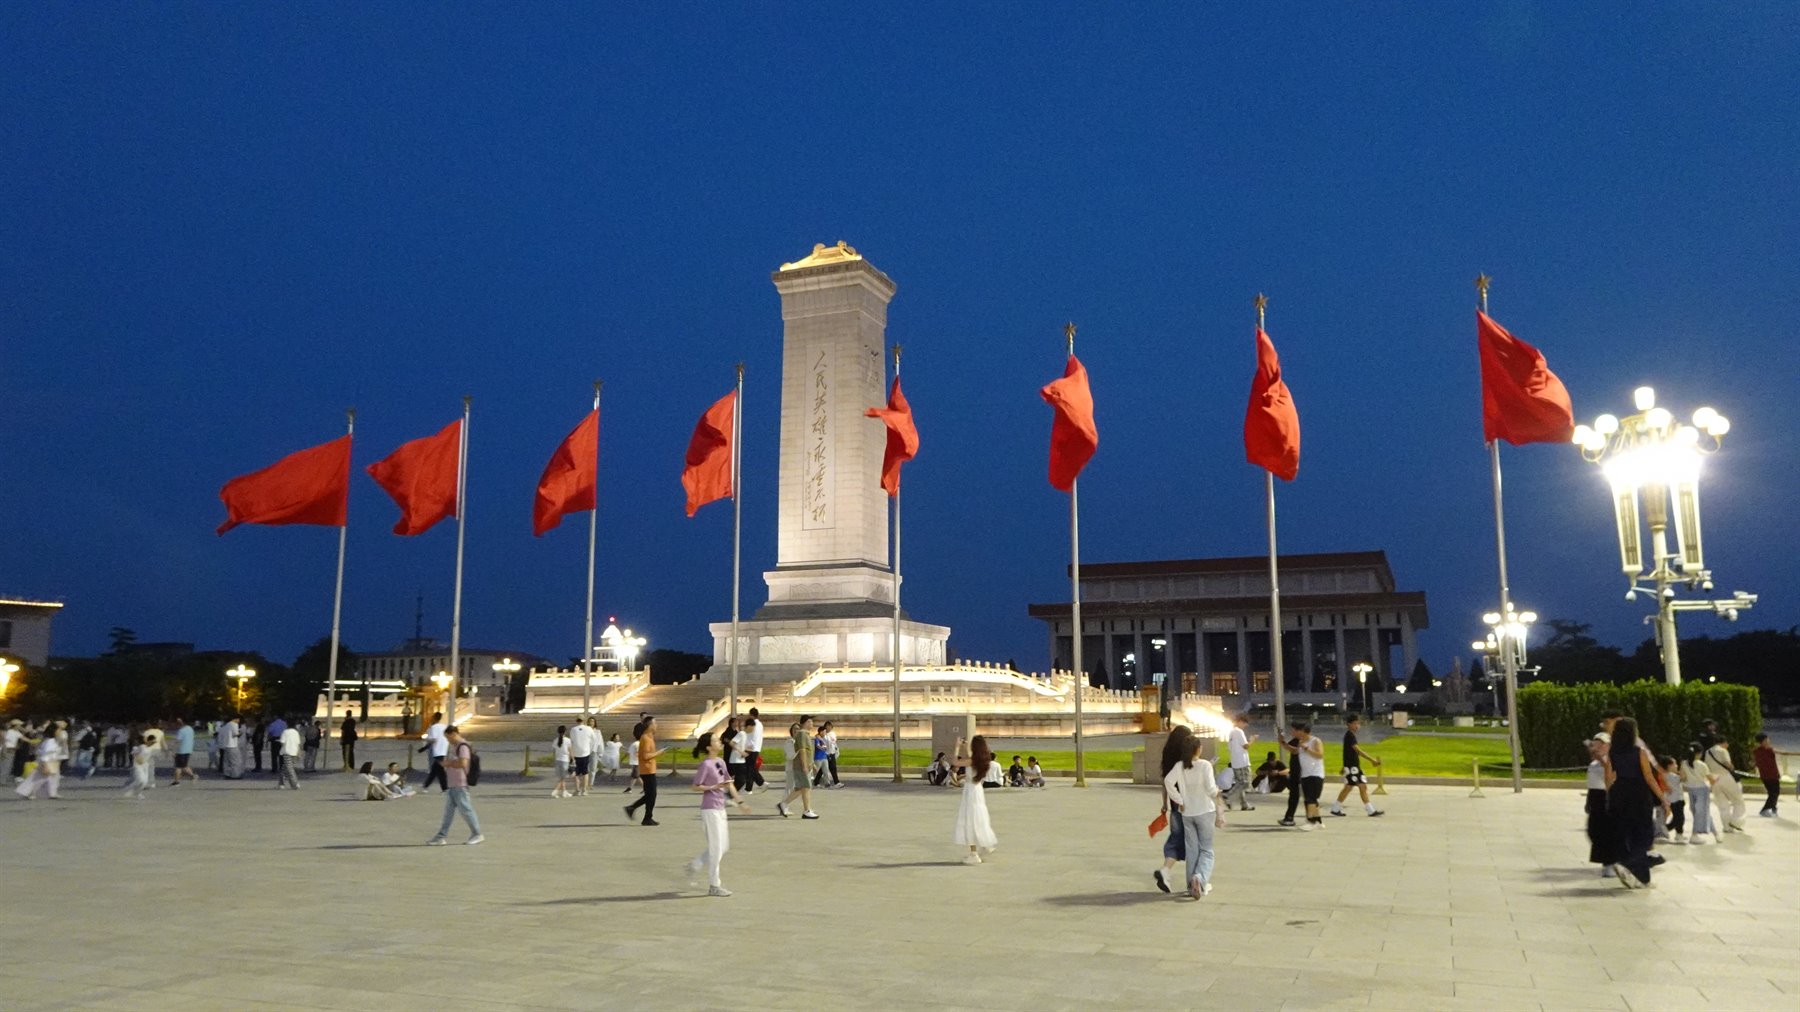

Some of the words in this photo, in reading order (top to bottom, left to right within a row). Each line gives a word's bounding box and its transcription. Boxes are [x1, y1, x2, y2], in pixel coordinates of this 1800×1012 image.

[811, 351, 828, 524] 人民英雄永垂不朽
